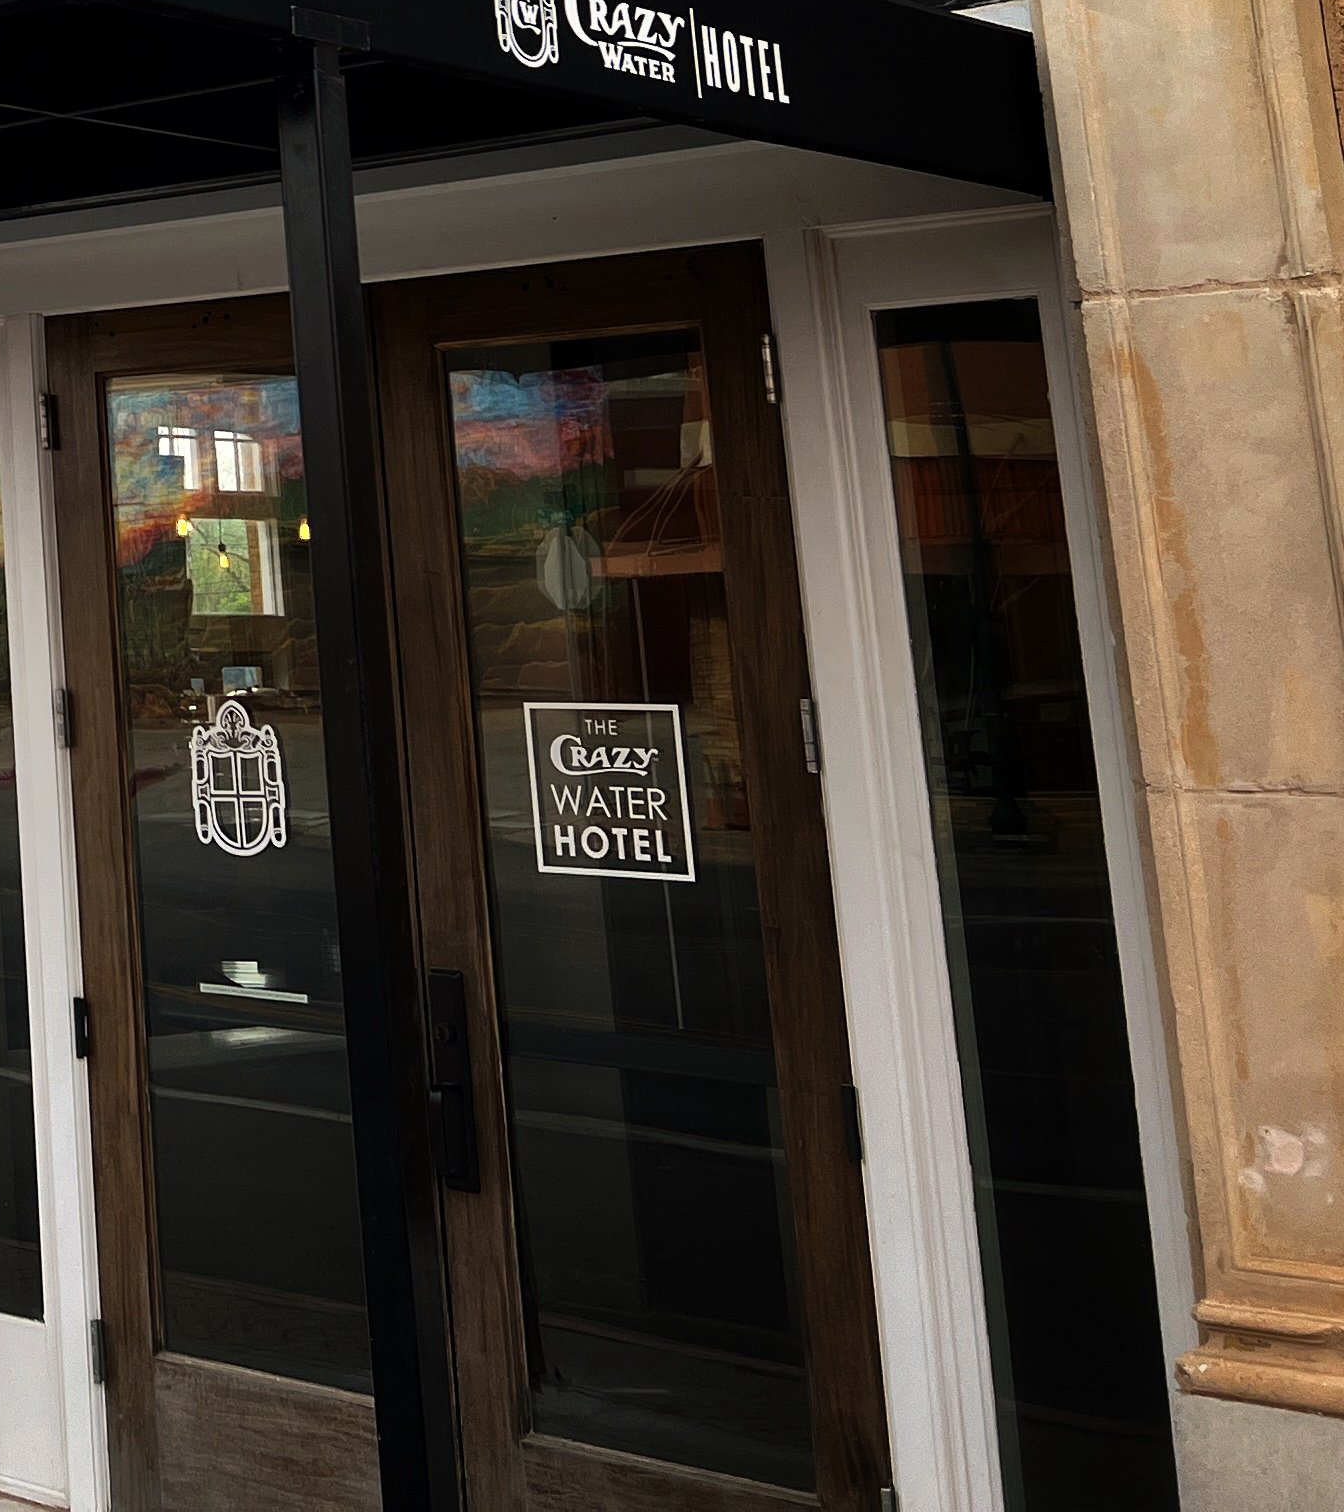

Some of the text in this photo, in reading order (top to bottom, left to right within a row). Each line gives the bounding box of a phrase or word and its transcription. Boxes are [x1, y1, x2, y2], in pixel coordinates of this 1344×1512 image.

[597, 40, 676, 84] WATER
[701, 25, 791, 105] HOTEL
[584, 718, 618, 736] THE
[549, 734, 659, 777] CRAZY
[550, 783, 668, 821] WATER
[553, 824, 672, 864] HOTEL
